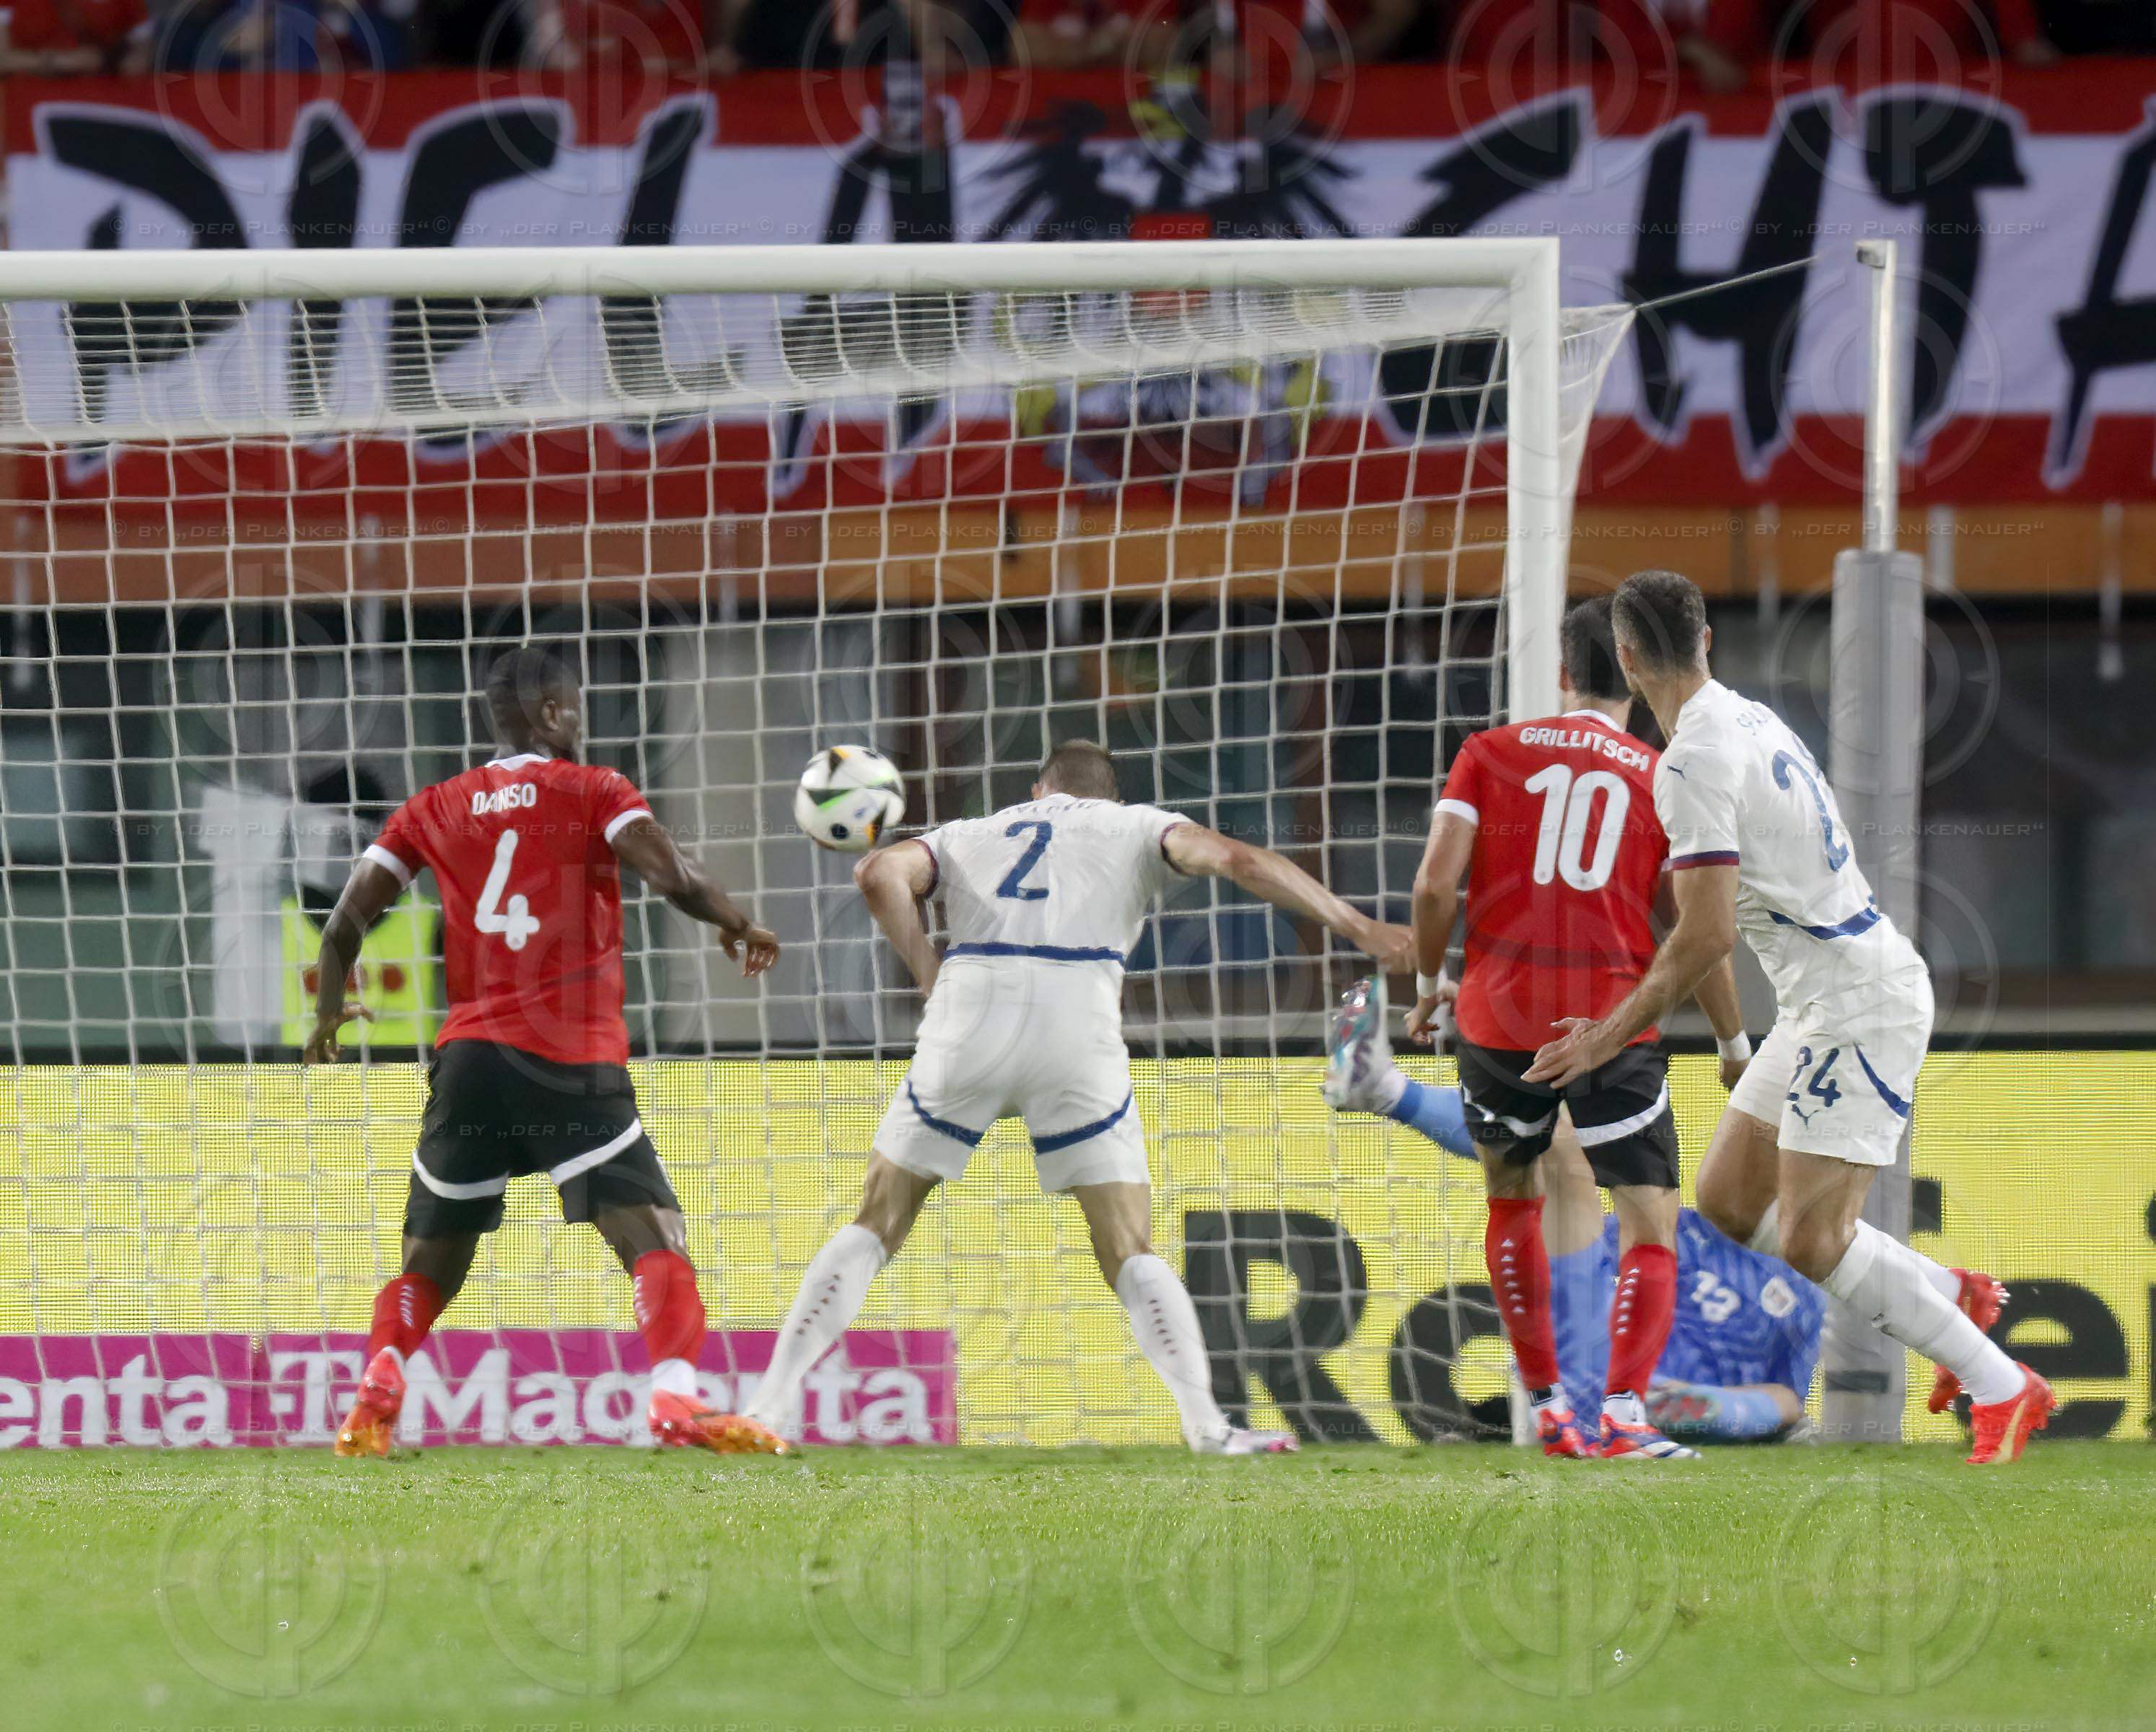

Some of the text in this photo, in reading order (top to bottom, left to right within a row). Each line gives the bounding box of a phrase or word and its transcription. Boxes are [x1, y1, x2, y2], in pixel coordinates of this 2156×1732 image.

[1519, 725, 1650, 772] GRILLITSCH
[471, 783, 537, 816] DANSO
[1524, 762, 1631, 892] 10
[473, 829, 540, 951] 4
[996, 820, 1053, 901] 2
[0, 1354, 233, 1447] enta
